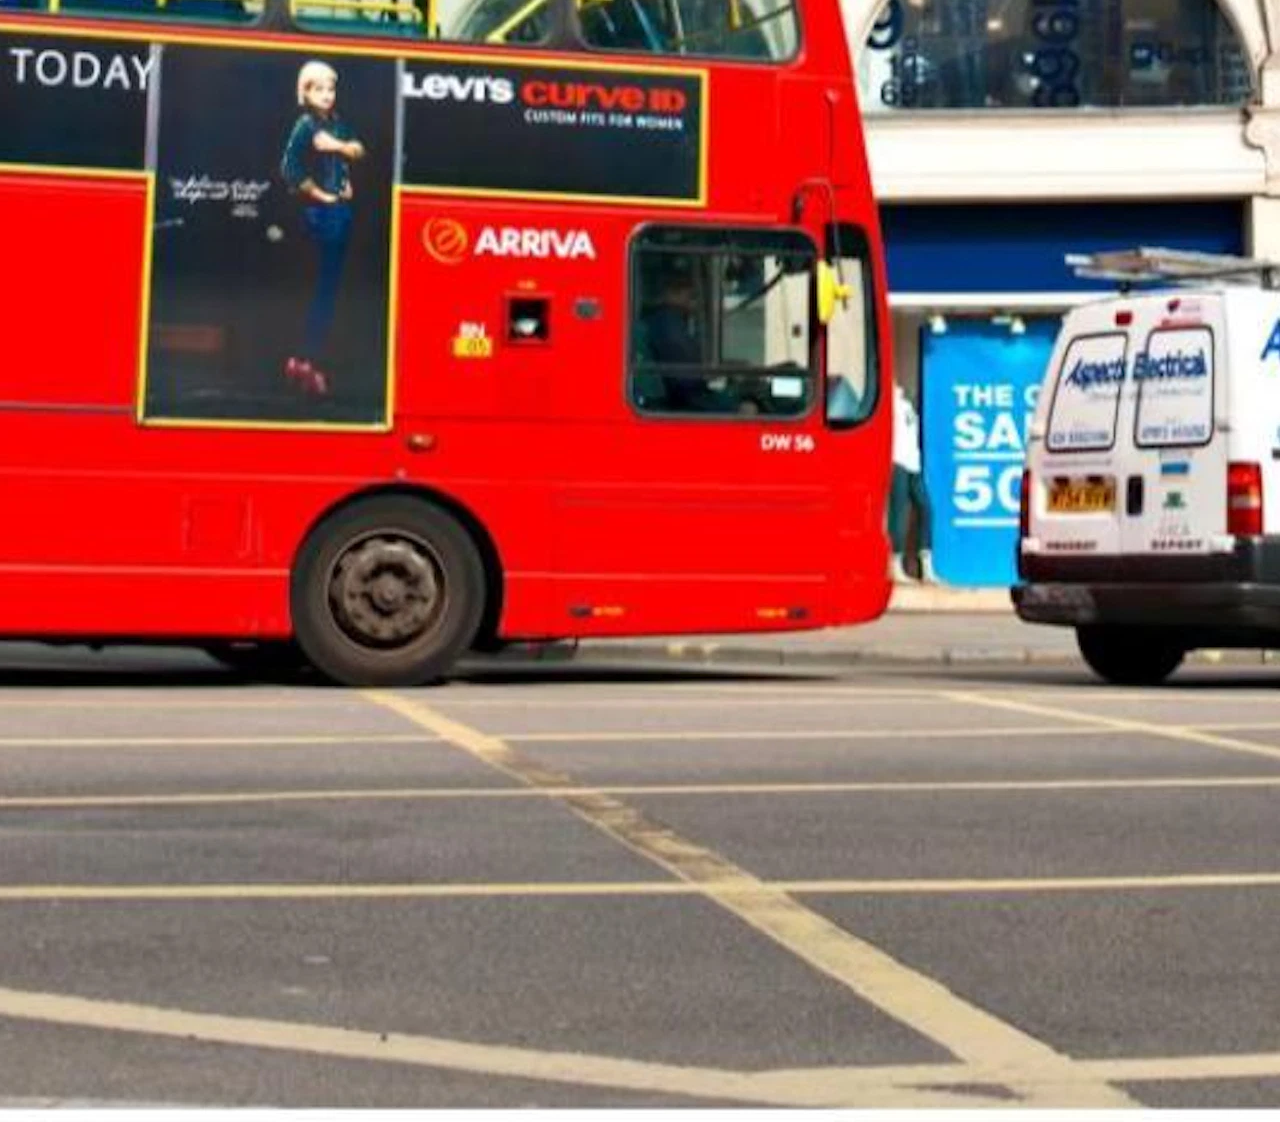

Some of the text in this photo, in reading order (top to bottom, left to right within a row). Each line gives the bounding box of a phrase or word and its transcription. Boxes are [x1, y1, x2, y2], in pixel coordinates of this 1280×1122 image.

[11, 47, 156, 90] TODAY
[524, 107, 684, 131] CUSTOM FITS FOR WOMEN
[474, 226, 597, 261] ARRIVA
[1066, 347, 1207, 391] Aspects Electrical
[952, 384, 1015, 408] THE
[761, 433, 792, 452] DW
